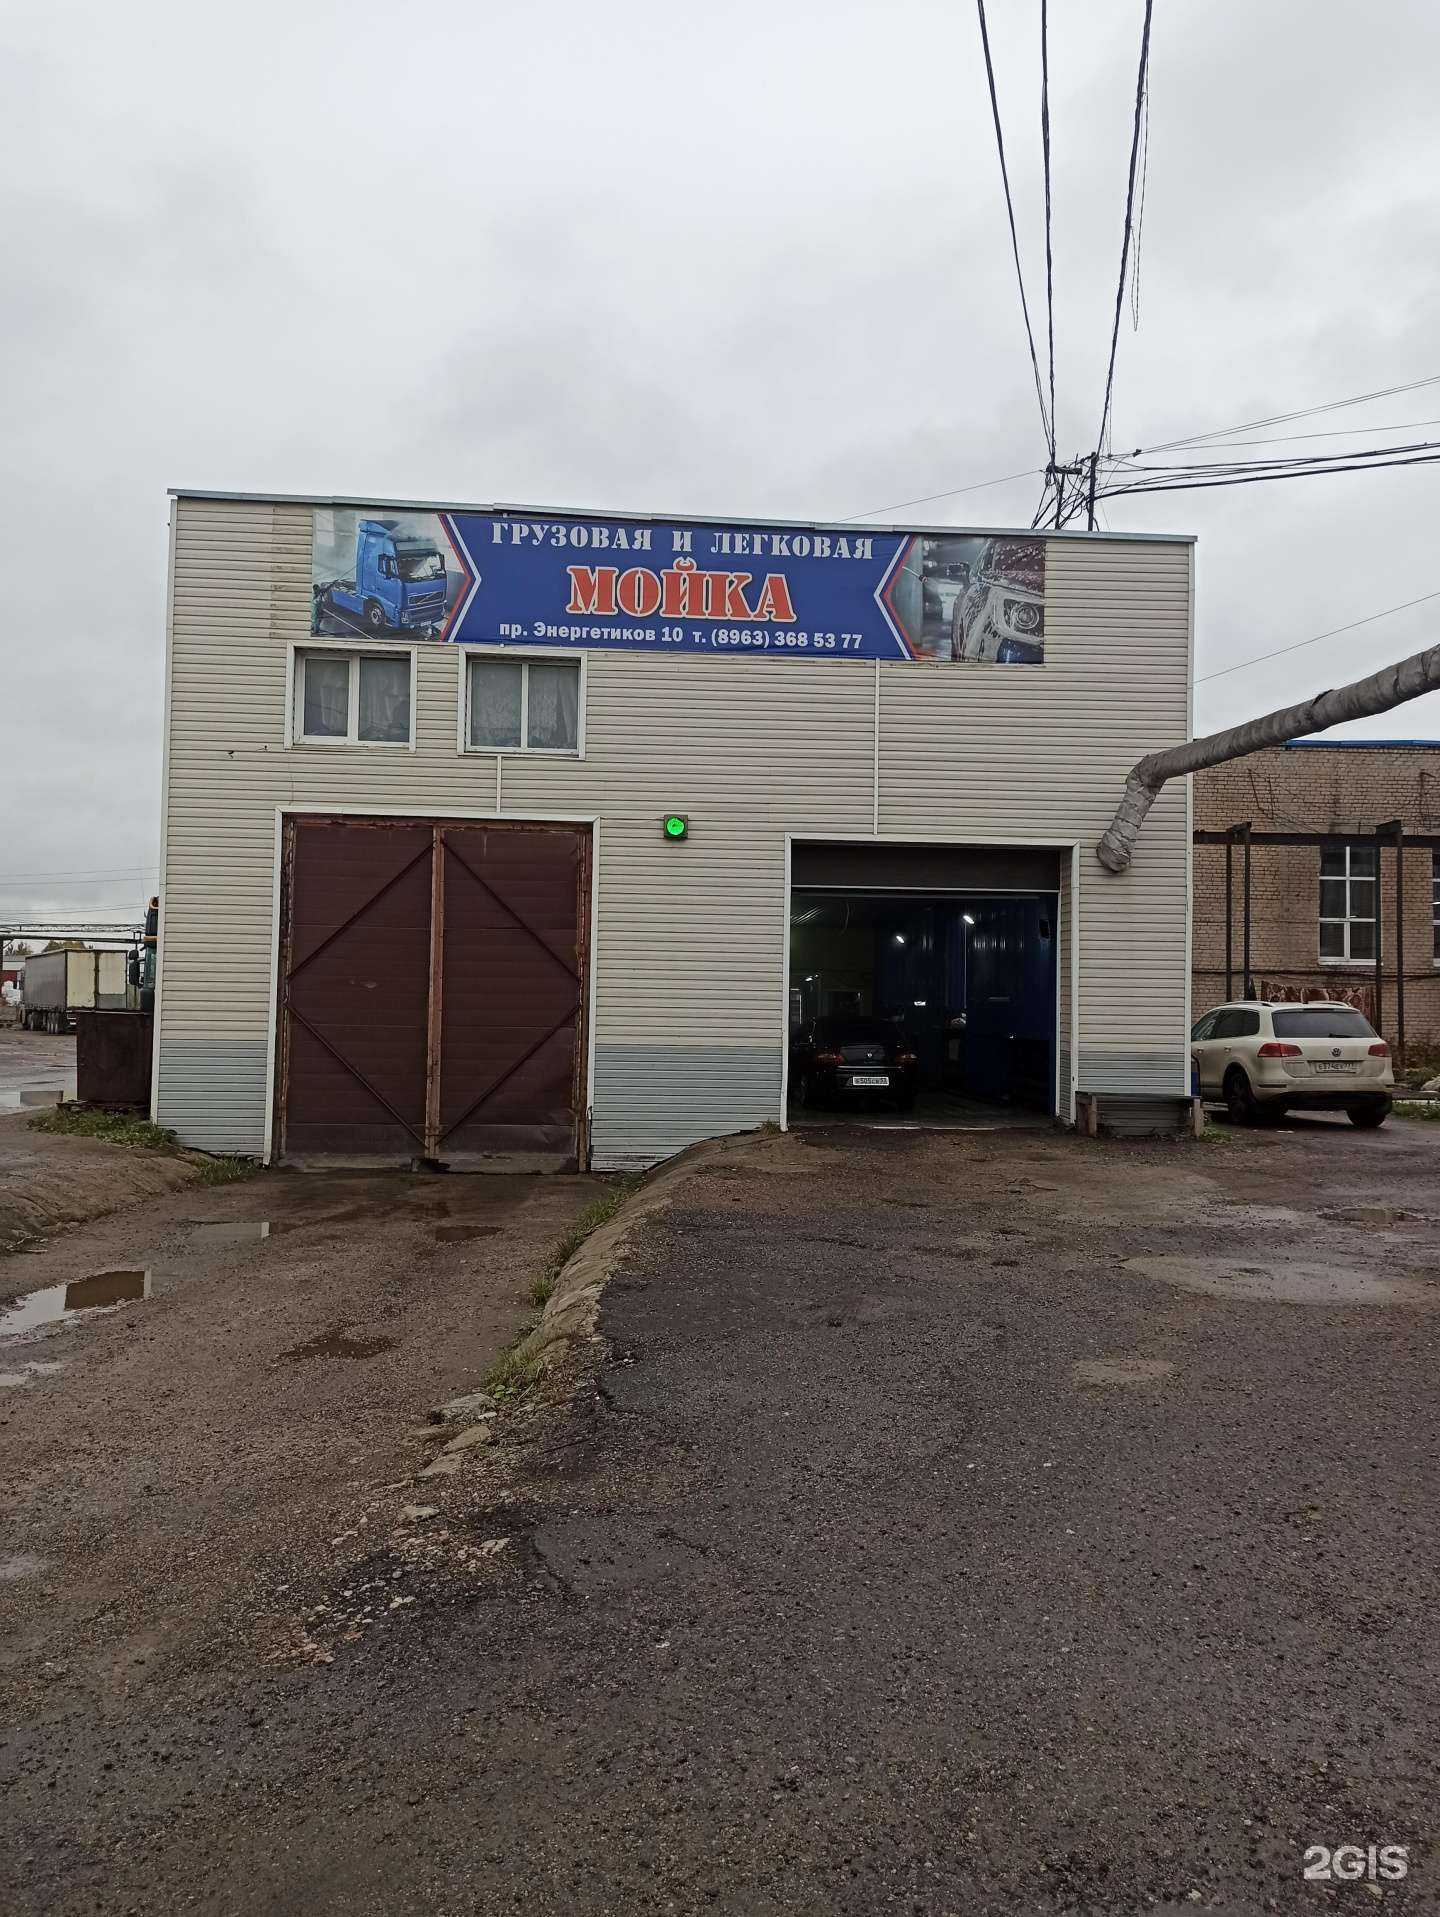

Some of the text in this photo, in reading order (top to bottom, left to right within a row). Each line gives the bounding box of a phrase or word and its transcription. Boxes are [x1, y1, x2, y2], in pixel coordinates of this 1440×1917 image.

[491, 522, 874, 560] ГРУЗОВАЯ И ЛЕГКОВАЯ
[565, 556, 798, 624] МОЙКА
[499, 621, 863, 649] пр. Энергетиков 10 т. (8963) 368 53 77
